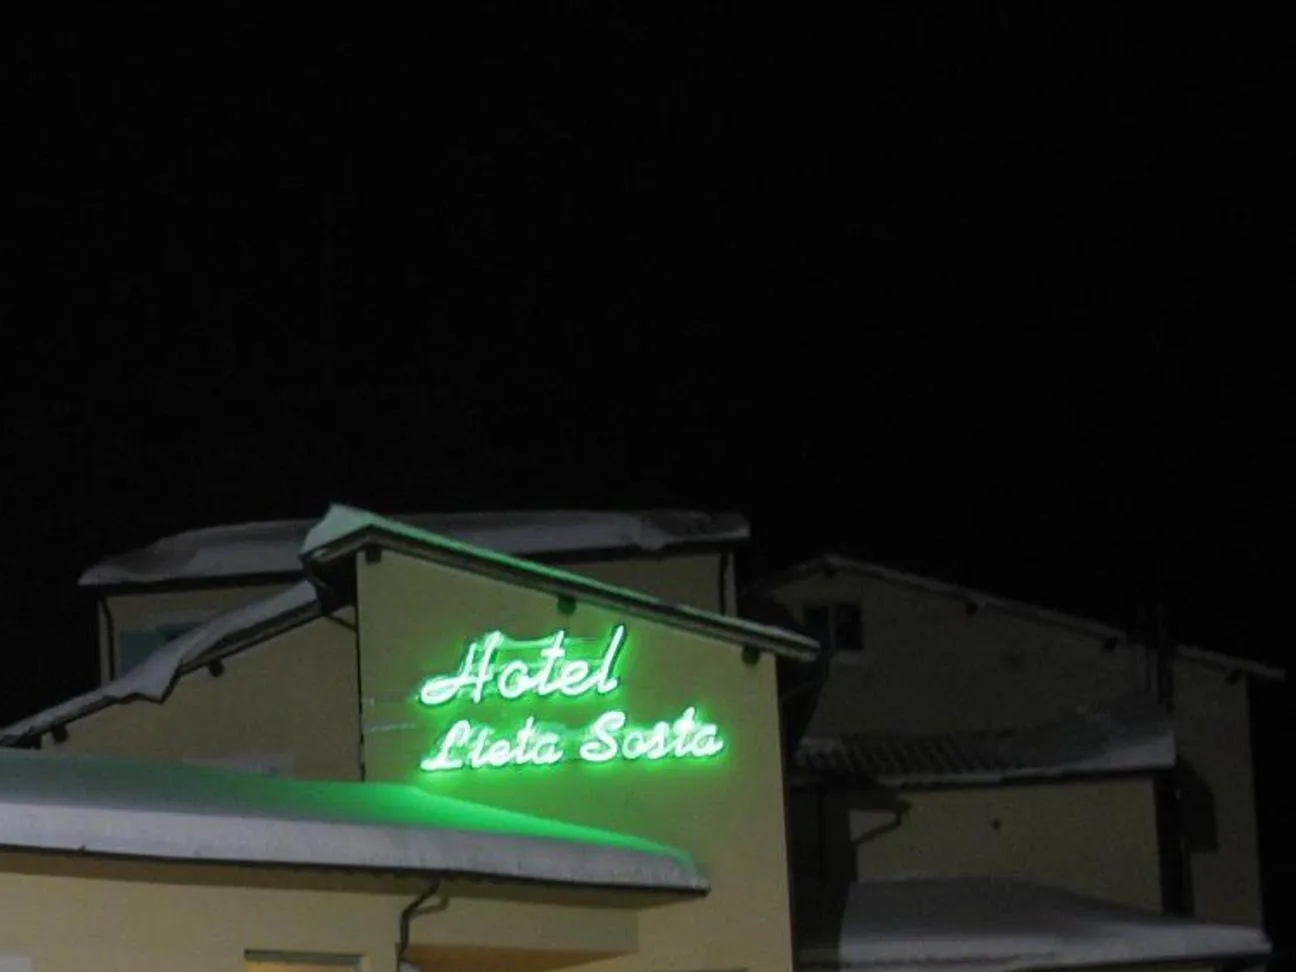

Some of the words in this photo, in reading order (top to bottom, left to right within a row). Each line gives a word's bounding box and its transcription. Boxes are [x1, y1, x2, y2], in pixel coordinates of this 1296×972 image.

[419, 624, 626, 705] Hotel
[419, 716, 565, 772] Lieta
[579, 706, 724, 763] Sosta
